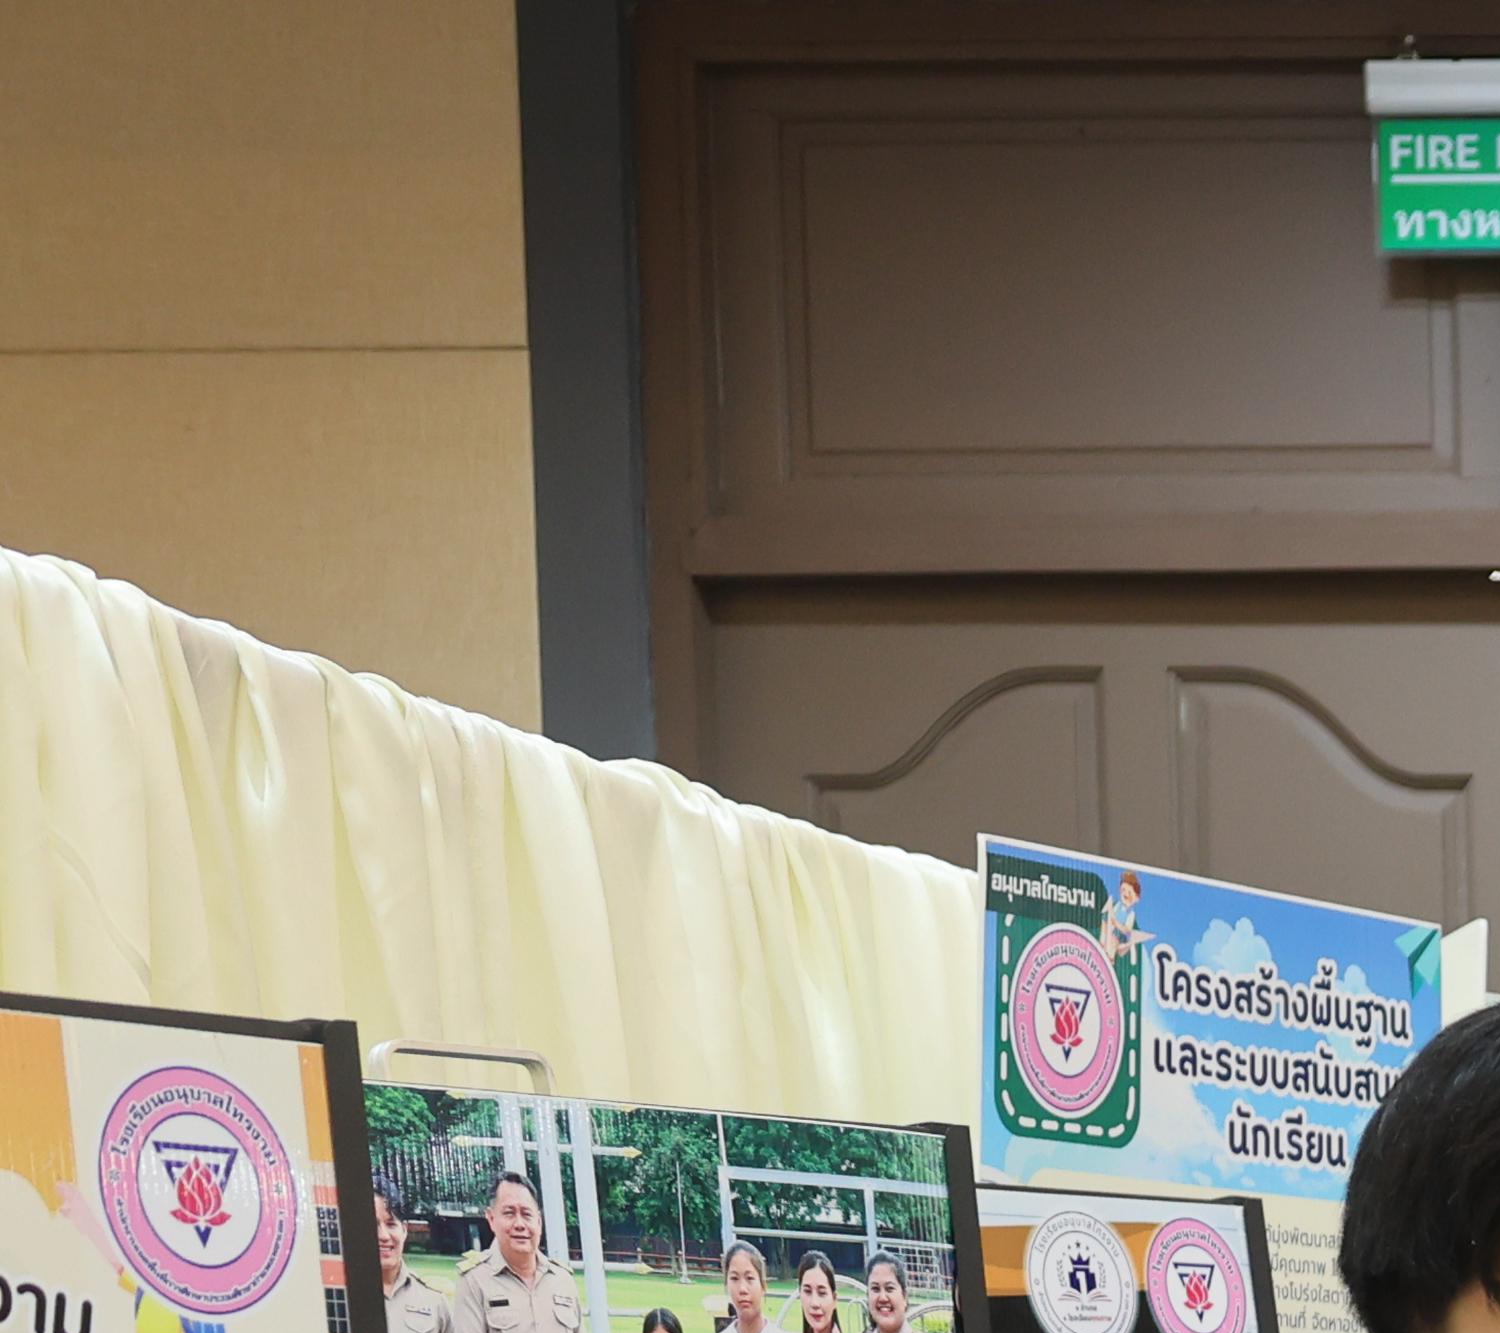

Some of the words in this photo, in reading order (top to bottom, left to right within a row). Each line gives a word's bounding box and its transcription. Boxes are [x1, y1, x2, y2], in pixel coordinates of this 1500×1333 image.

[1390, 133, 1481, 170] FIRE
[1154, 945, 1411, 1048] โครงสร้างพื้นฐาน
[1227, 1104, 1346, 1169] นักเรียน
